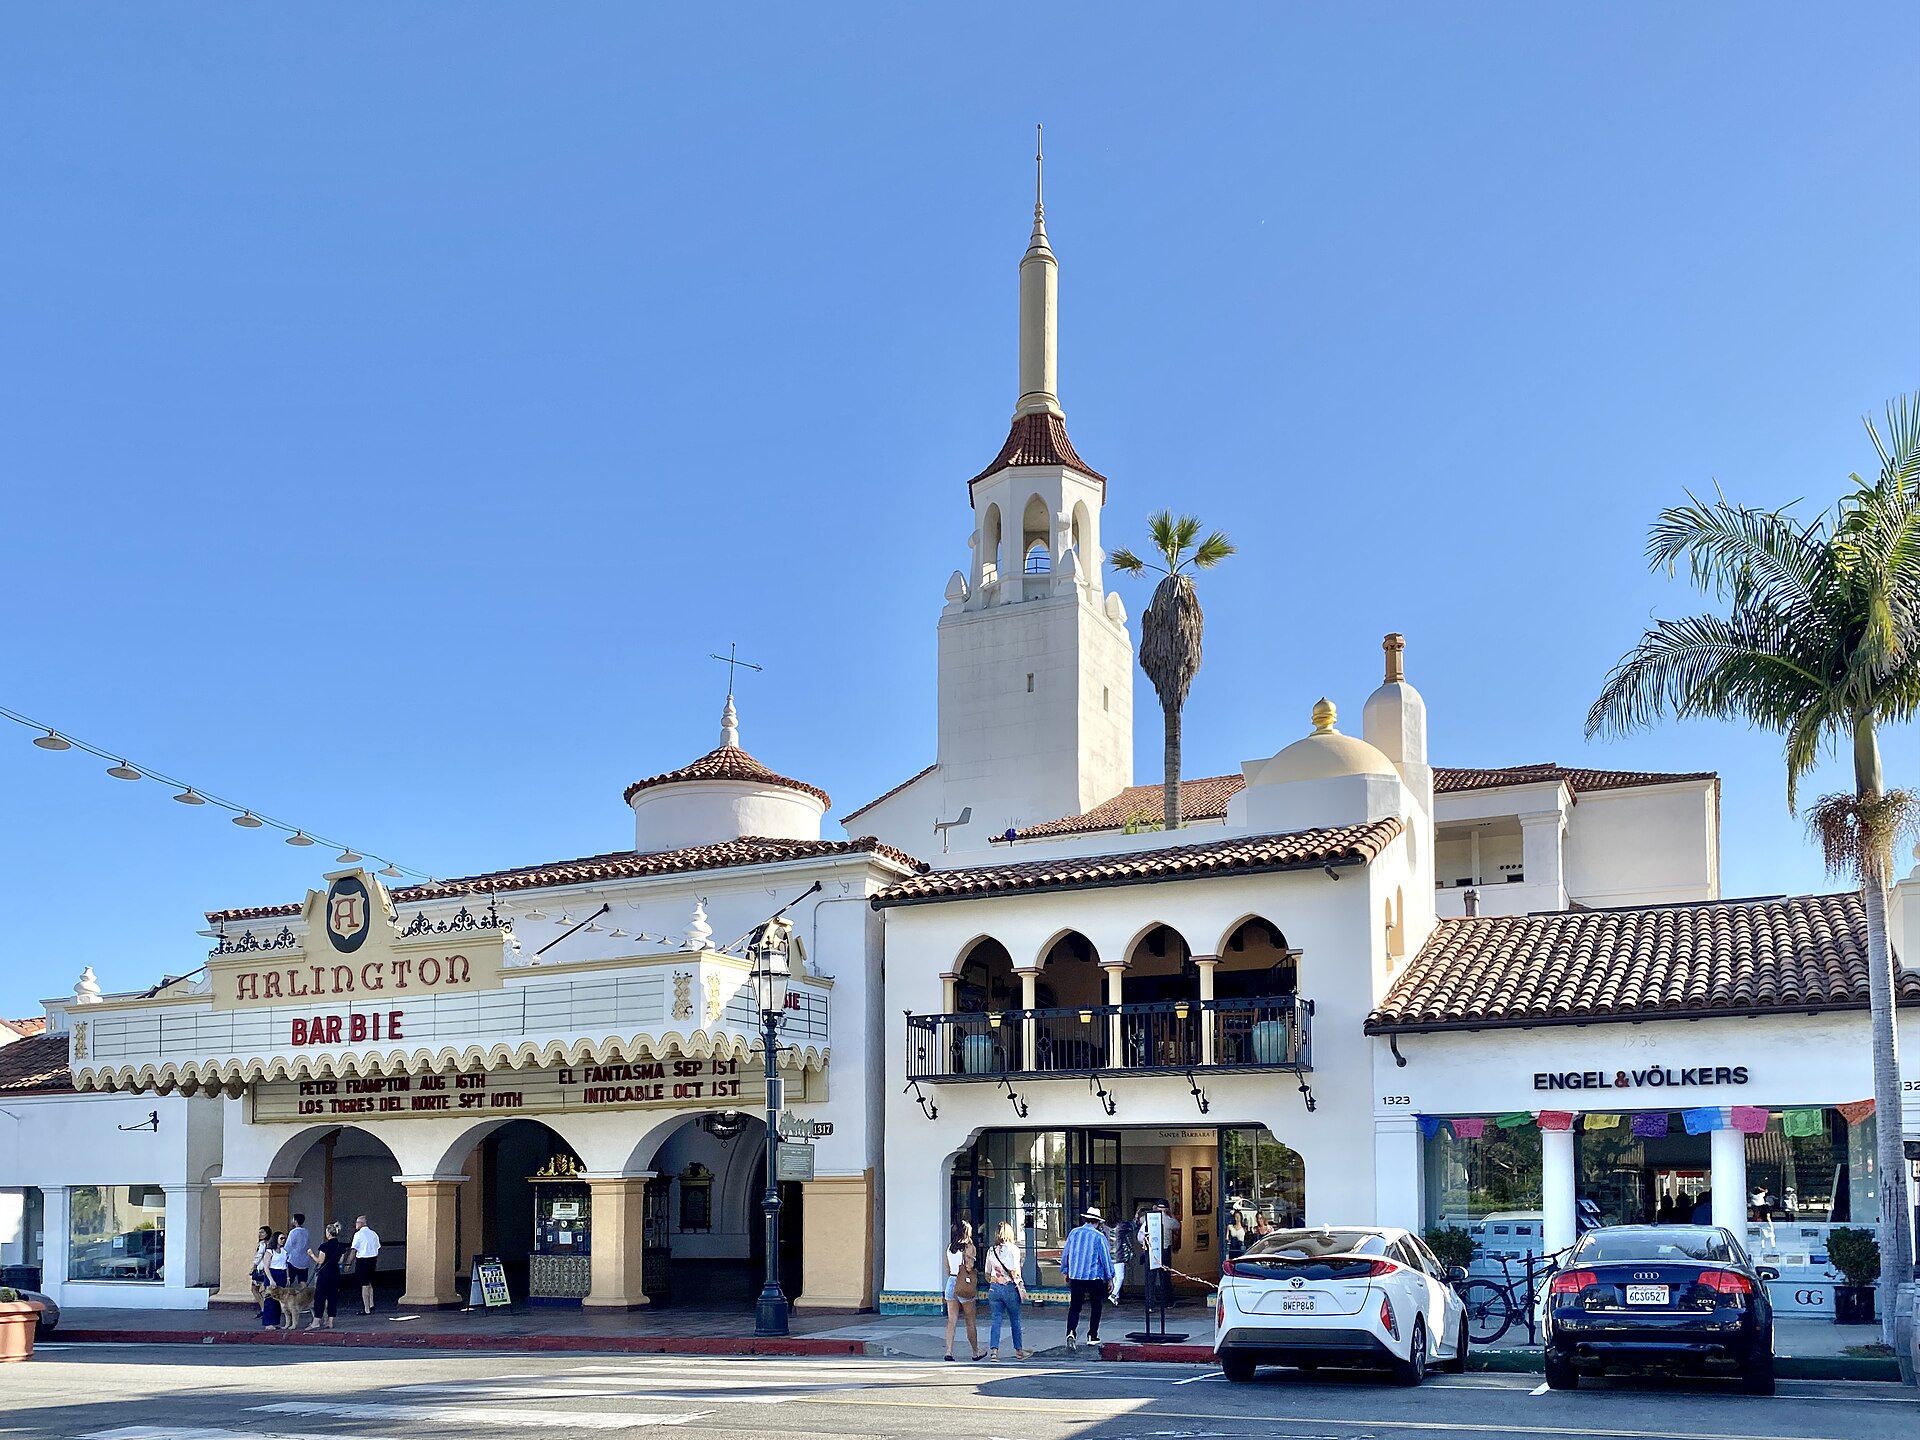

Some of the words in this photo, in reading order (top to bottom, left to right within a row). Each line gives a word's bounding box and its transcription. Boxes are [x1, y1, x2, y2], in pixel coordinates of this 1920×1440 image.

[335, 898, 360, 930] A
[237, 955, 471, 1000] ARLINGTON
[292, 1011, 404, 1046] BARBIE
[300, 1080, 337, 1096] PETER
[346, 1077, 410, 1094] FRAMPTON
[419, 1075, 446, 1091] AUG
[456, 1073, 486, 1089] 16TH
[558, 1069, 577, 1085] EL
[584, 1063, 665, 1083] FANTASMA
[673, 1061, 703, 1077] SEP
[299, 1099, 323, 1114] LOS
[329, 1096, 374, 1113] TIGRES
[379, 1096, 405, 1112] DEL
[412, 1094, 450, 1111] NORTE
[458, 1093, 486, 1108] SPT
[491, 1092, 522, 1107] 10TH
[584, 1084, 664, 1103] INTOCABLE
[673, 1082, 703, 1099] OCT
[1382, 1096, 1411, 1105] 1323
[814, 1124, 830, 1134] 1317
